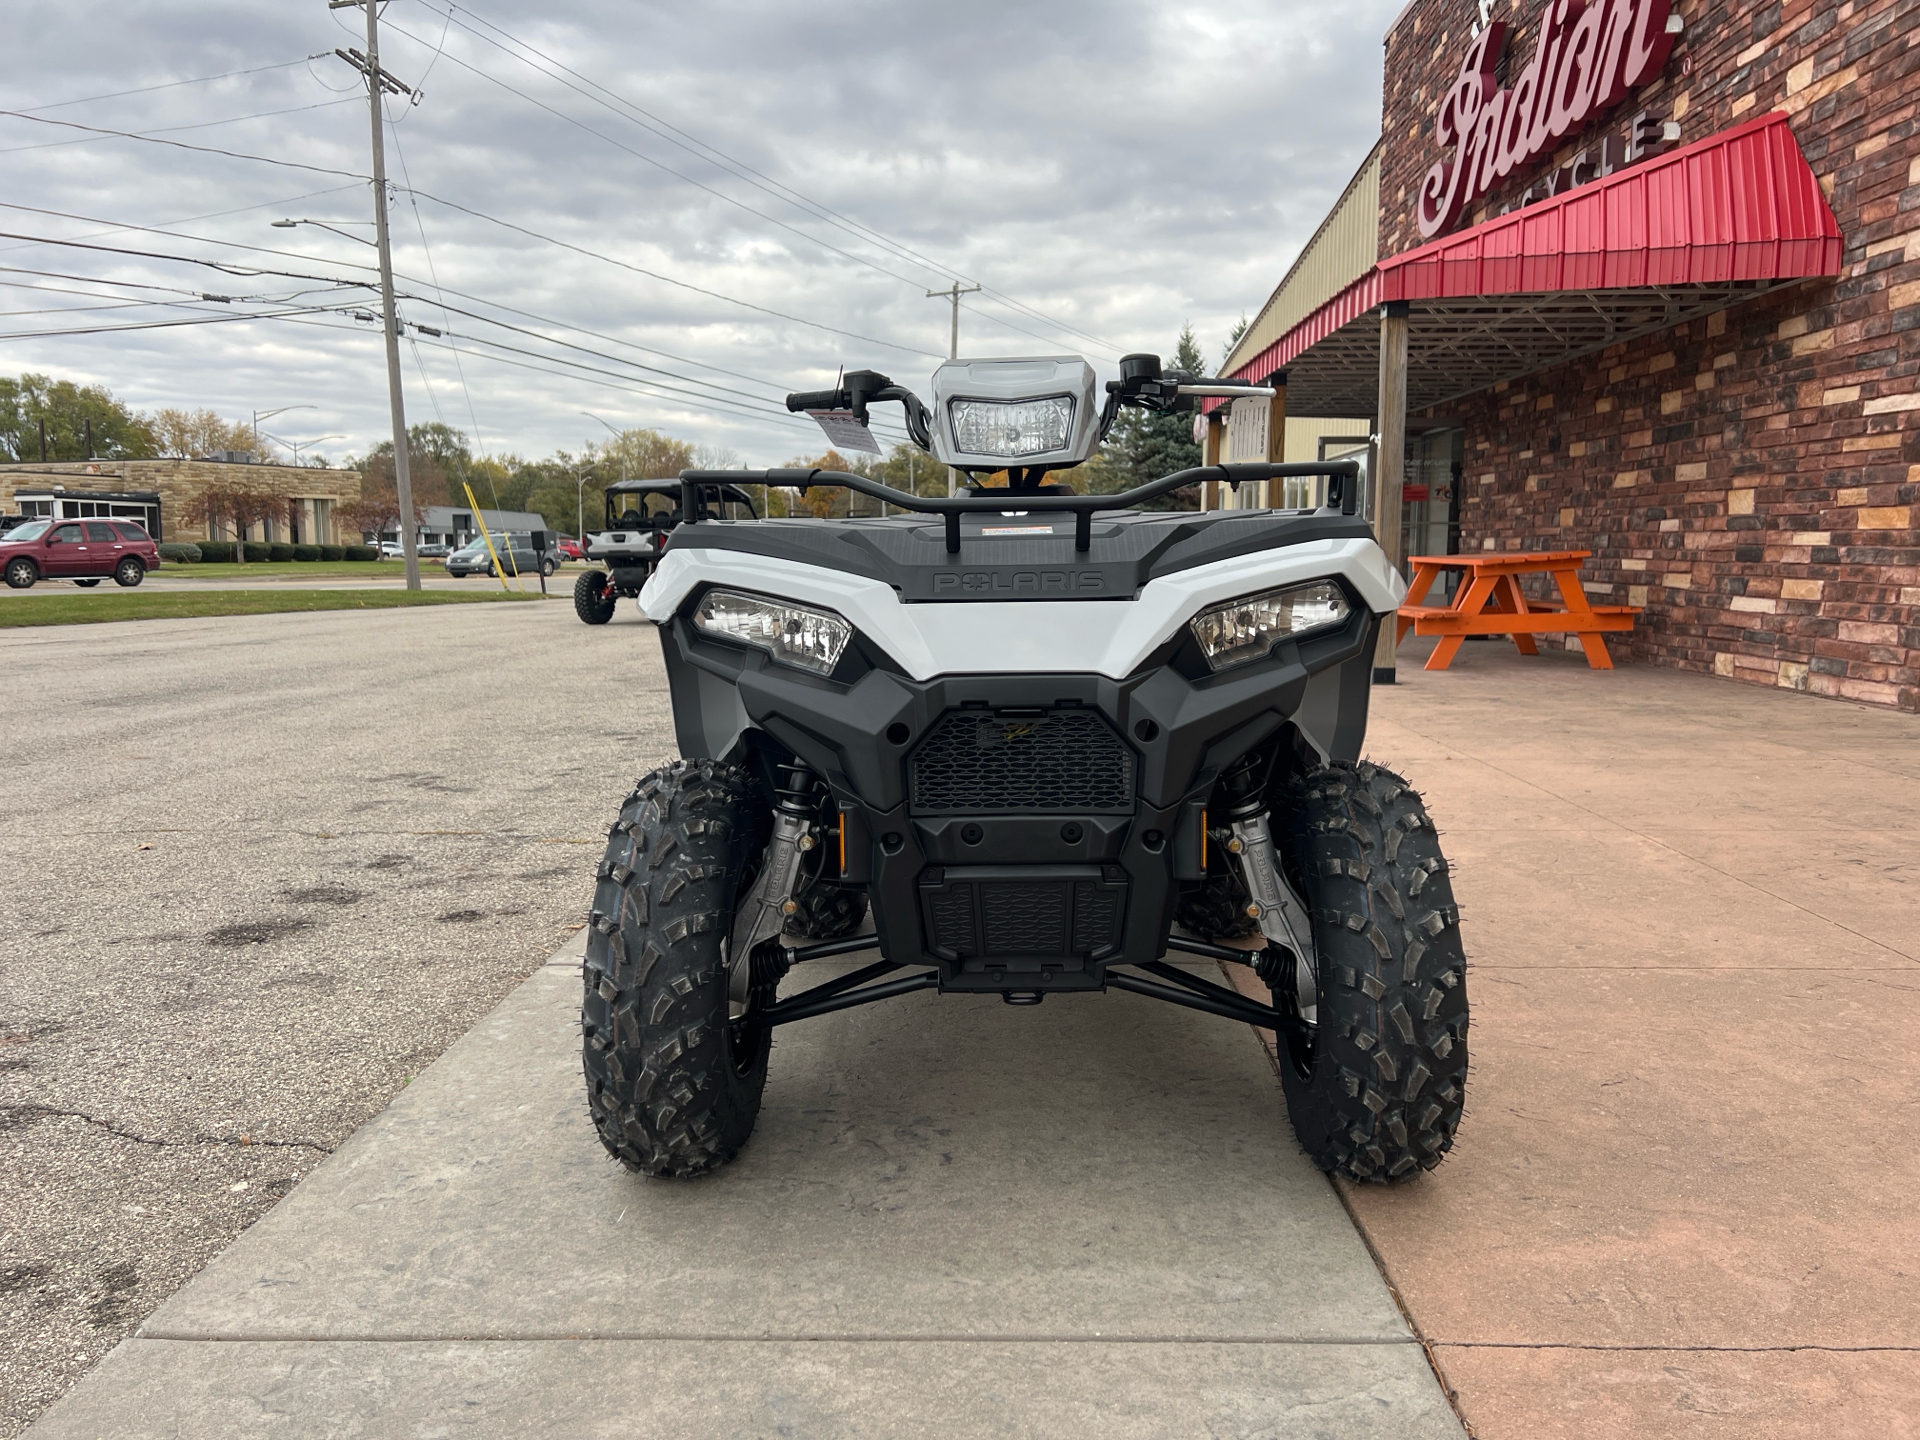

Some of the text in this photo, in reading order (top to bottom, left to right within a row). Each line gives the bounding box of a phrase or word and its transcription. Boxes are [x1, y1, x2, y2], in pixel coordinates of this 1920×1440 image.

[1417, 0, 1660, 238] Indian
[1500, 110, 1652, 216] CYCLE
[932, 571, 1105, 593] POLARIS
[1254, 849, 1276, 901] POLARIS
